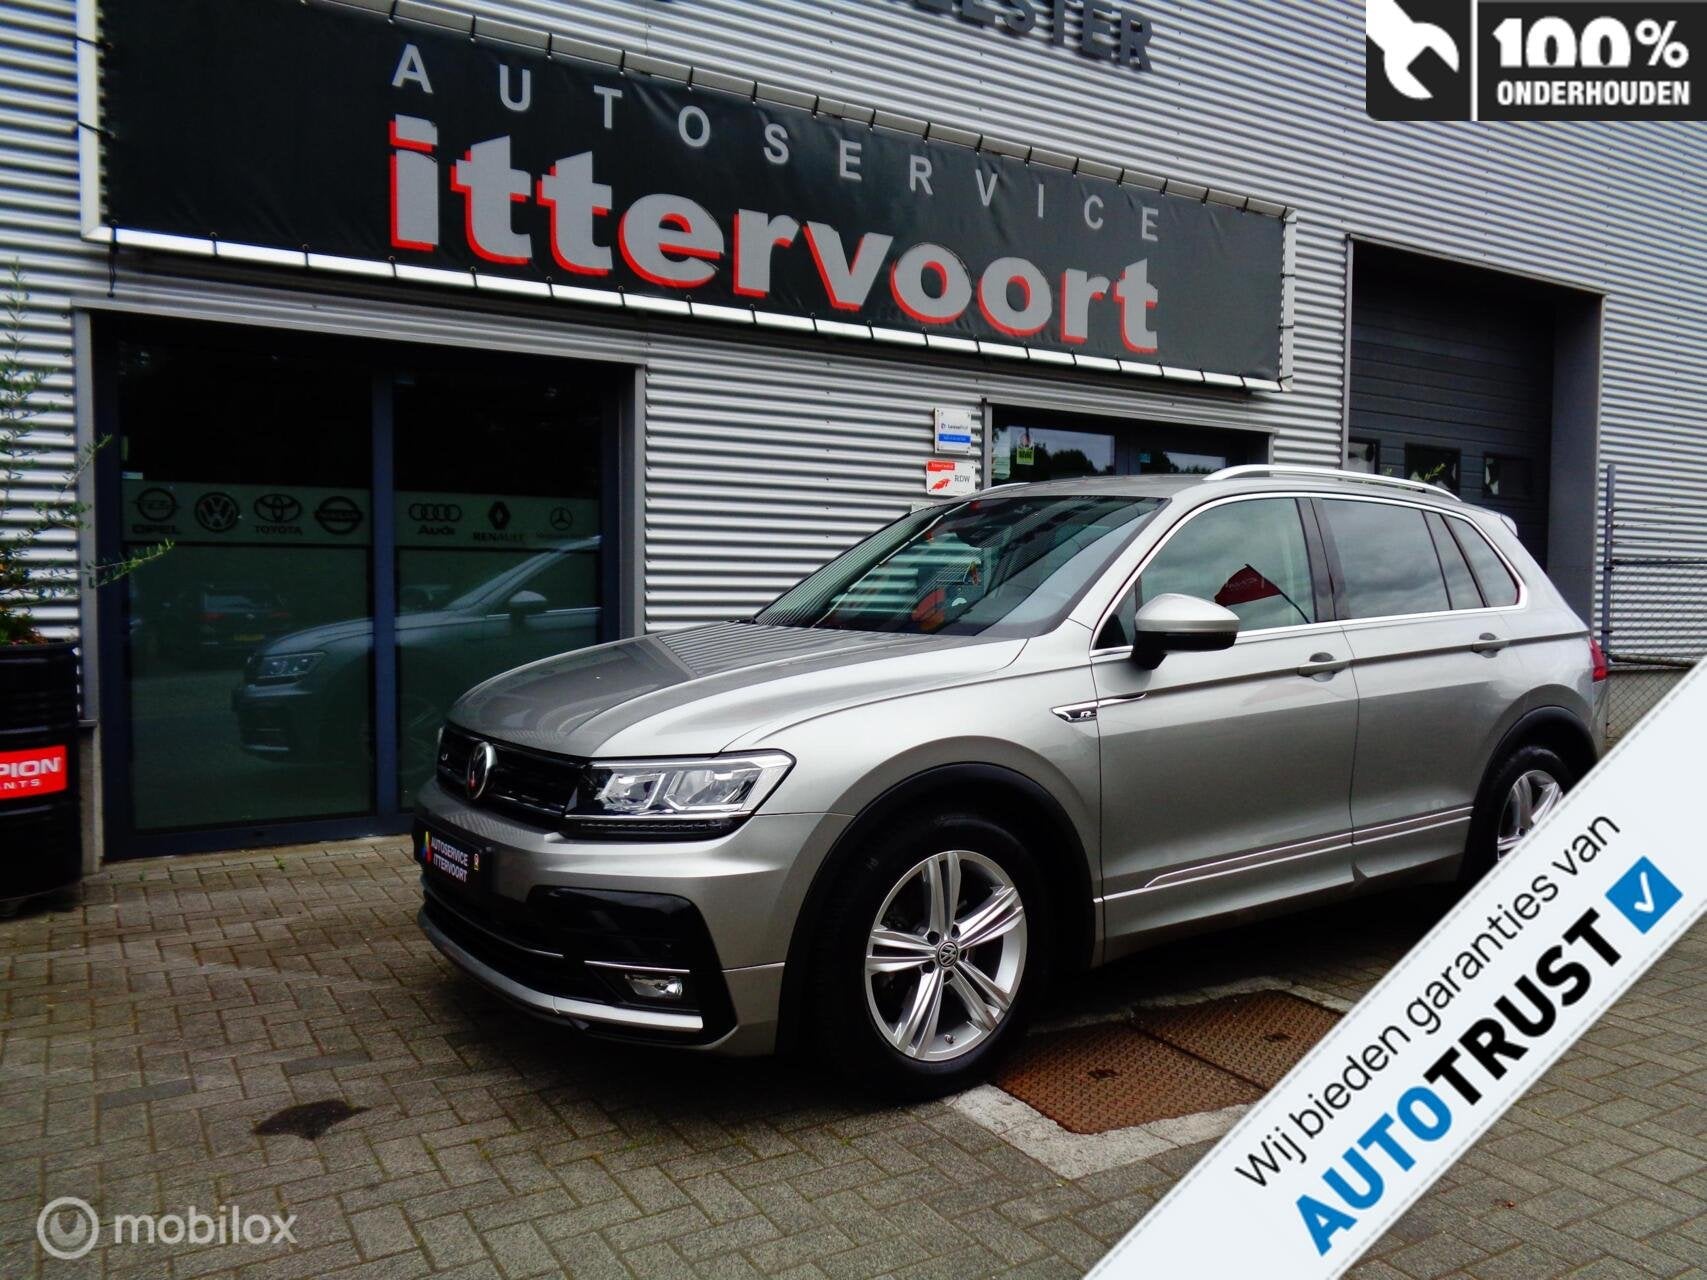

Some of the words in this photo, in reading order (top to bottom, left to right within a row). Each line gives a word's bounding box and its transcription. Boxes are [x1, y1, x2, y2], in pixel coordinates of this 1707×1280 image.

[388, 113, 1159, 354] ittervoort
[953, 473, 971, 484] RDW
[254, 525, 304, 536] TOYOTA
[431, 836, 469, 867] AUTOSERVICE
[433, 852, 468, 883] ITTERVOORT
